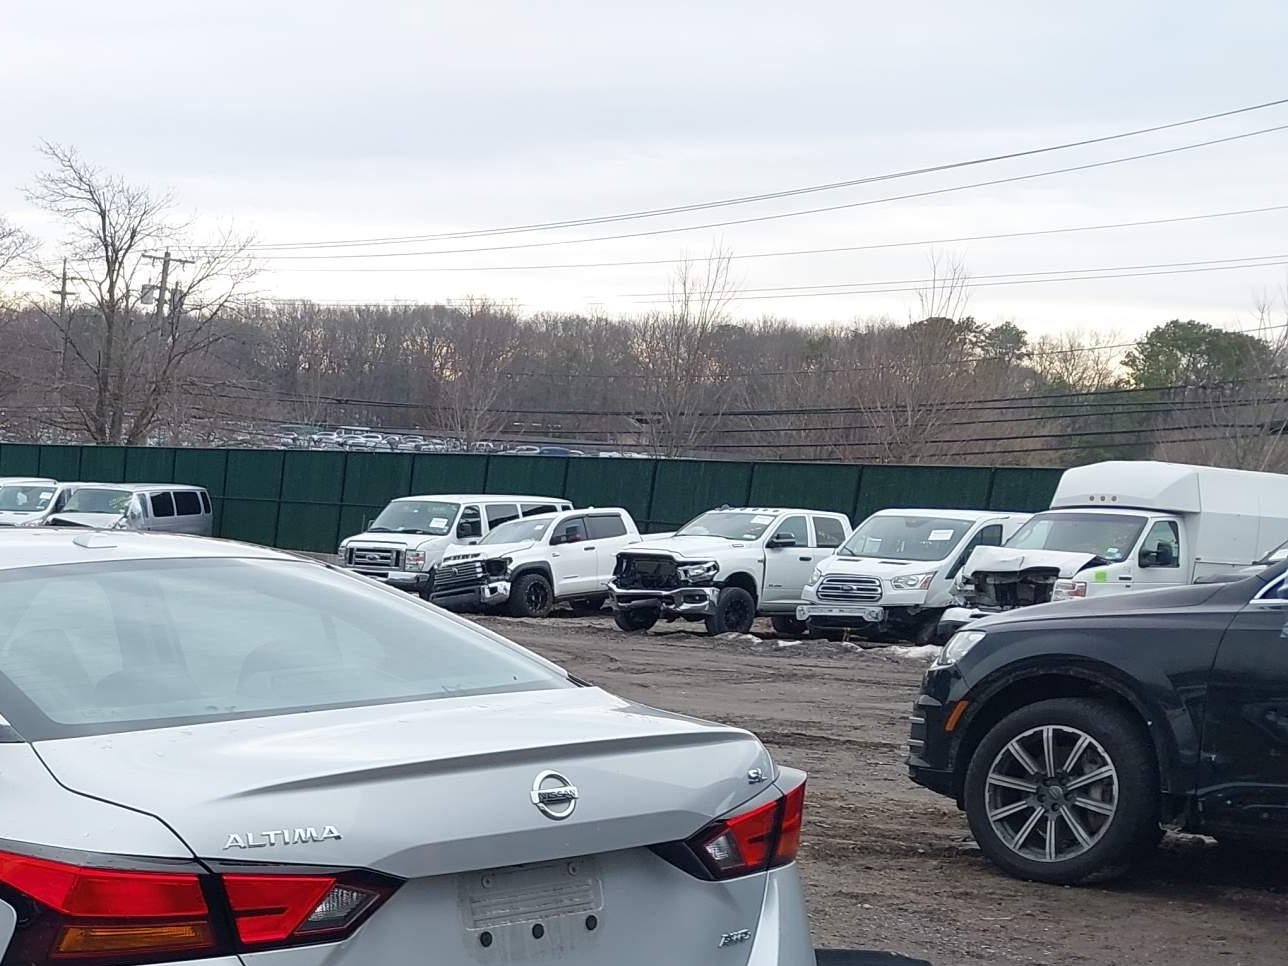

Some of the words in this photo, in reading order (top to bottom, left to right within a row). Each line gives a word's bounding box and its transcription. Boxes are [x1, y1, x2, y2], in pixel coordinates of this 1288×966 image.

[748, 768, 768, 784] SL
[538, 789, 576, 801] NISSAN
[223, 825, 343, 850] ALTIMA
